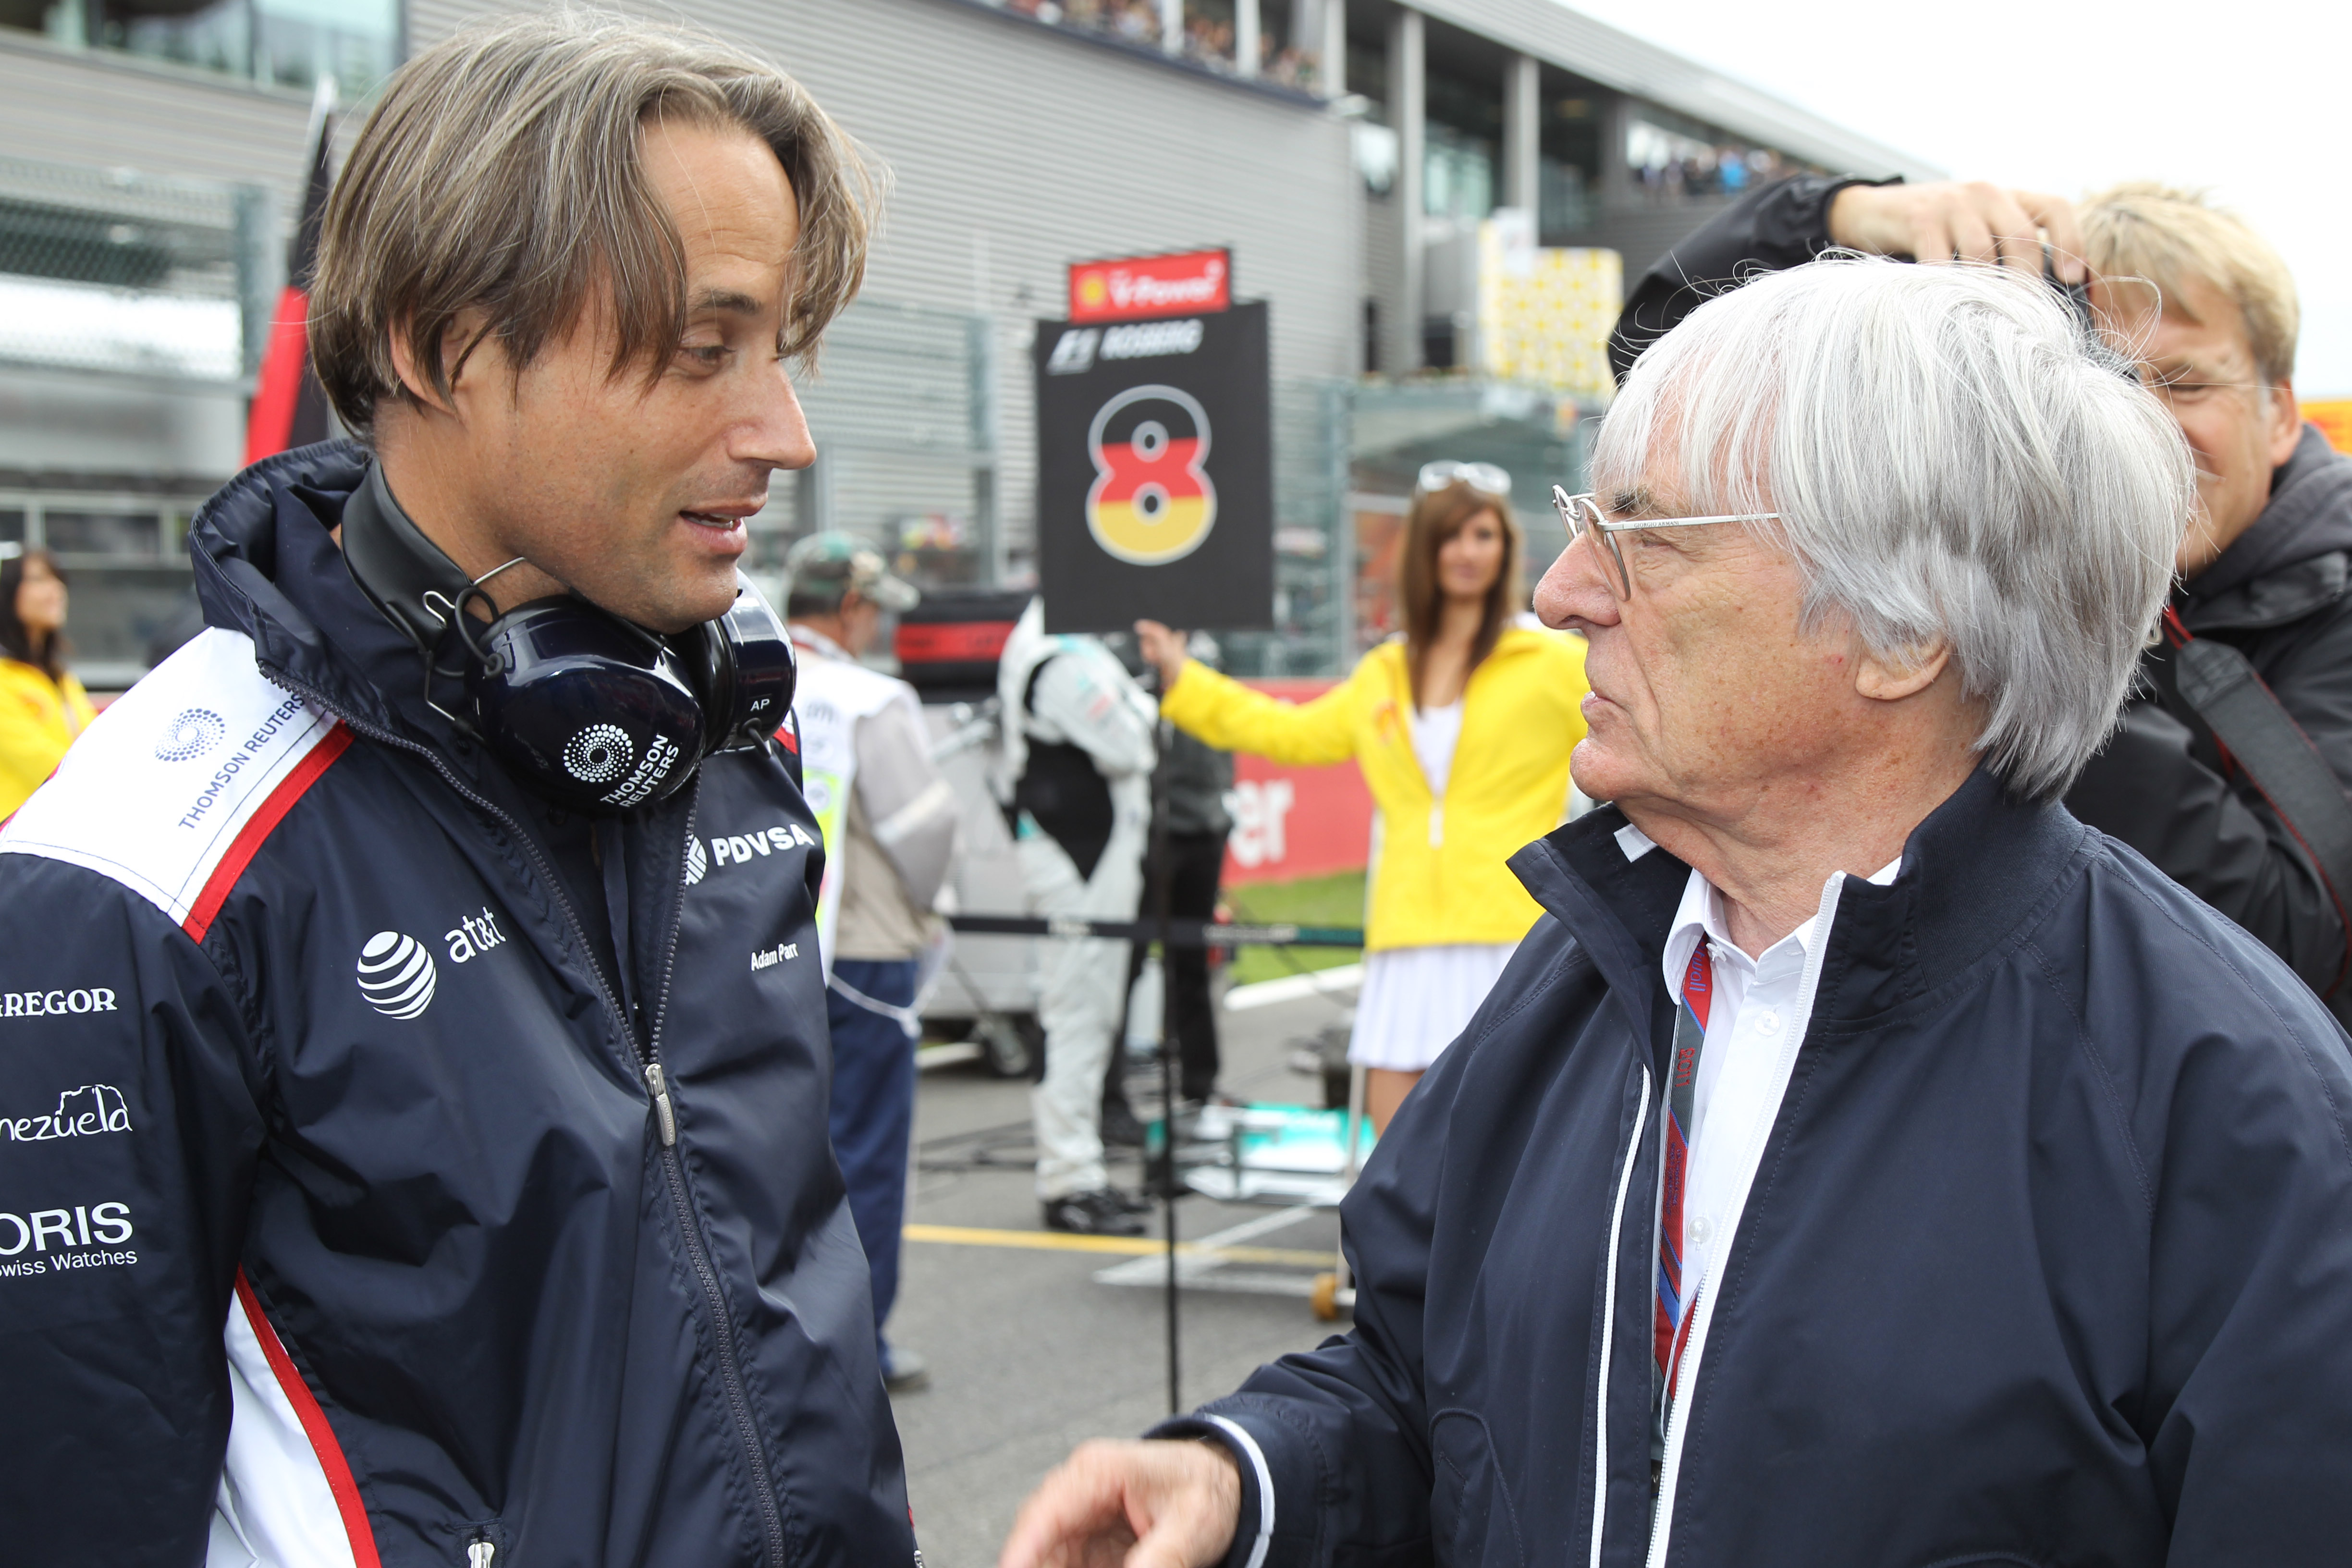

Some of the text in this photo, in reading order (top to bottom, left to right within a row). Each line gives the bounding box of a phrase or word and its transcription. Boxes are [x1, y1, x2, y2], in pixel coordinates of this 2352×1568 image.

[1086, 384, 1218, 566] 8
[750, 698, 770, 712] AP
[178, 693, 305, 829] THOMSON REUTERS
[600, 734, 668, 804] THOMSON
[619, 744, 679, 807] REUTERS
[711, 824, 815, 866] PDVSA
[445, 906, 506, 963] at&t
[751, 943, 799, 971] Adam Parr
[0, 988, 117, 1017] REGOR
[1675, 1047, 1695, 1087] 2011
[0, 1202, 133, 1255] ORIS
[0, 1250, 138, 1277] wiss Watches
